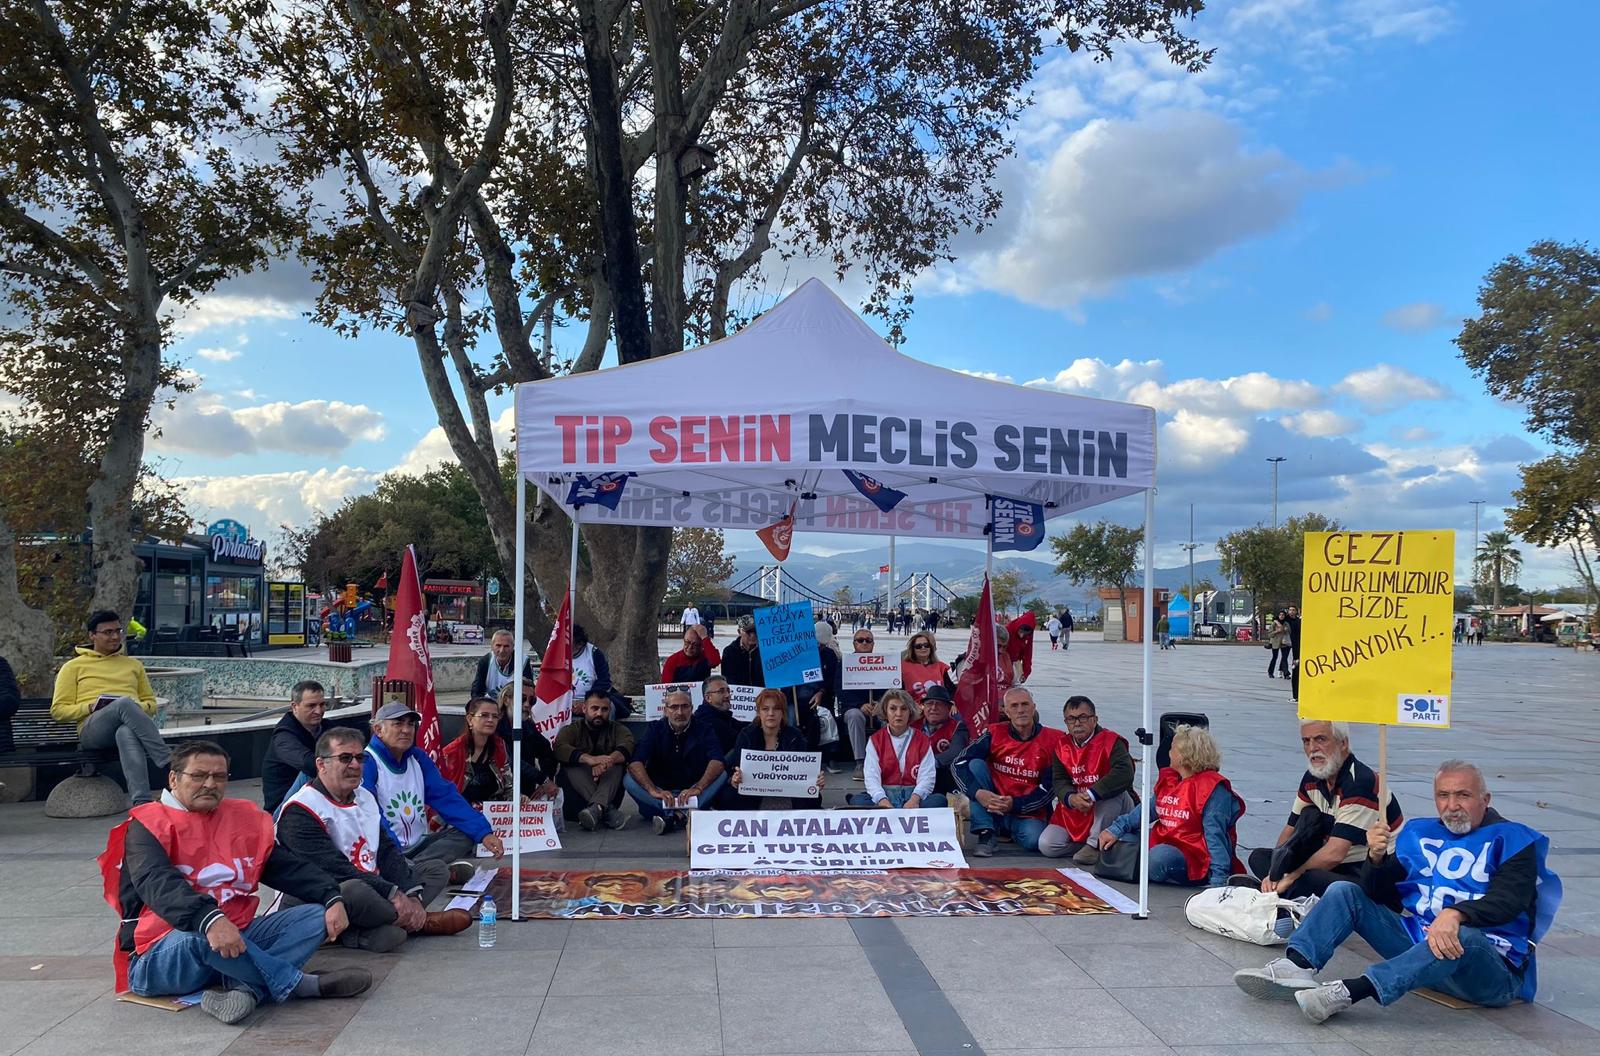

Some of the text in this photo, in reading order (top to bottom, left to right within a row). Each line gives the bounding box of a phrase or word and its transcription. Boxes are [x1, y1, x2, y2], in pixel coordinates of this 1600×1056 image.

[1323, 531, 1405, 567] GEZİ
[1308, 570, 1452, 595] ONURUMUZDUR
[1337, 594, 1409, 620] BİZDE
[1304, 624, 1415, 678] ORADAYDIK
[1403, 698, 1441, 713] SOL
[717, 818, 768, 838] CAN
[898, 815, 931, 834] VE
[697, 840, 956, 855] GEZİ TUTSAKLARINA
